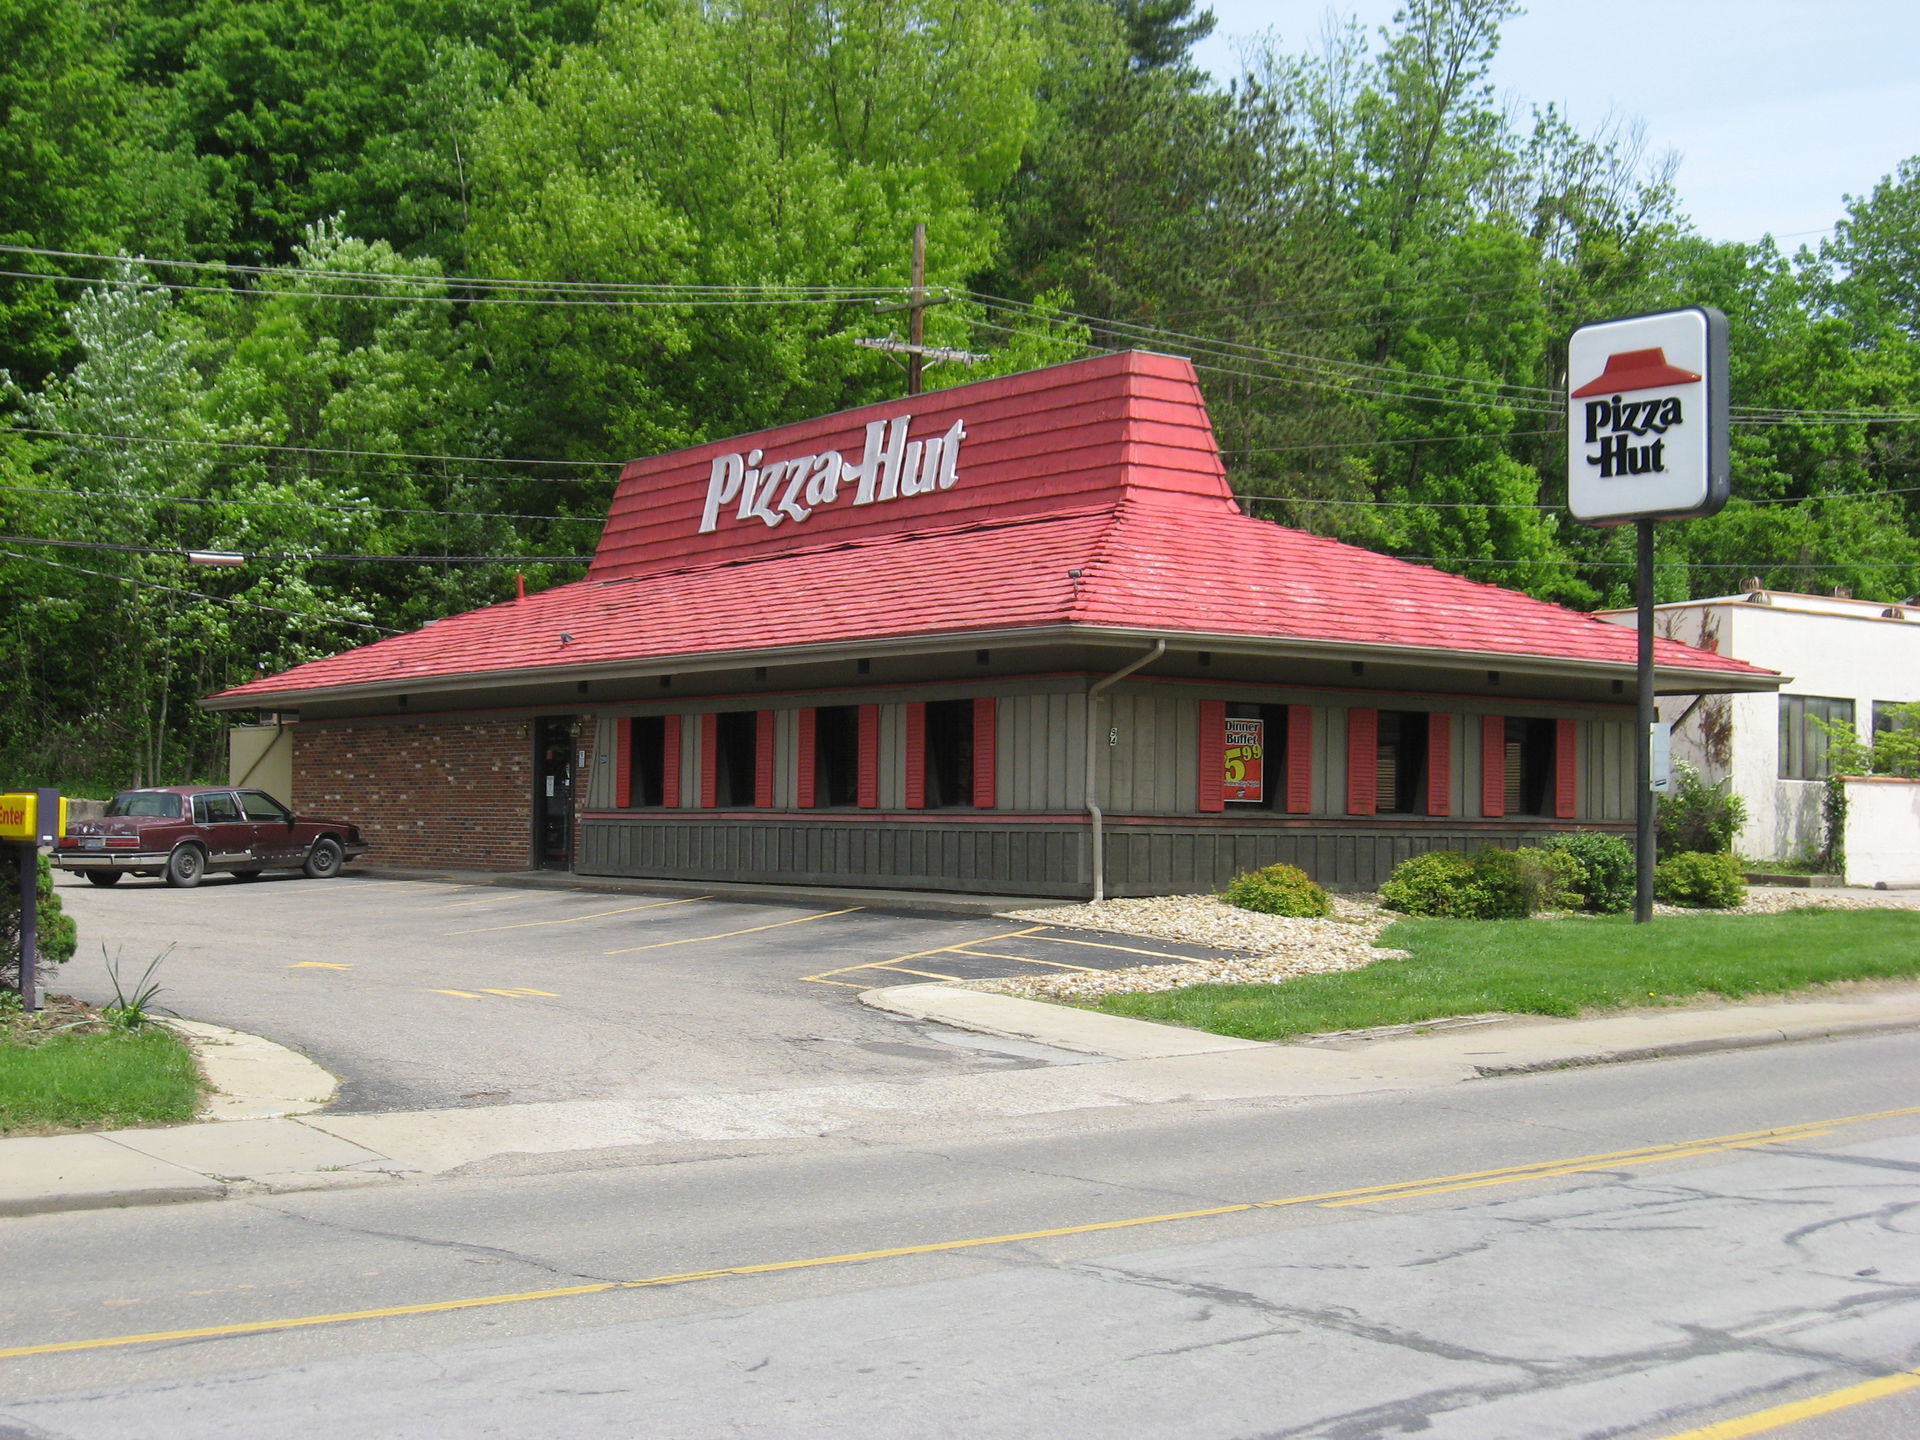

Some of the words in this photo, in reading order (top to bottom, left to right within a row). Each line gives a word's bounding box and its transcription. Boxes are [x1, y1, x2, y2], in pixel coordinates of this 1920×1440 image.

[1585, 395, 1683, 443] Pizza
[698, 448, 843, 534] Pizza
[841, 414, 967, 506] Hut
[1586, 434, 1665, 478] Hut
[1224, 720, 1259, 732] Dinner
[1226, 733, 1257, 745] Buffet
